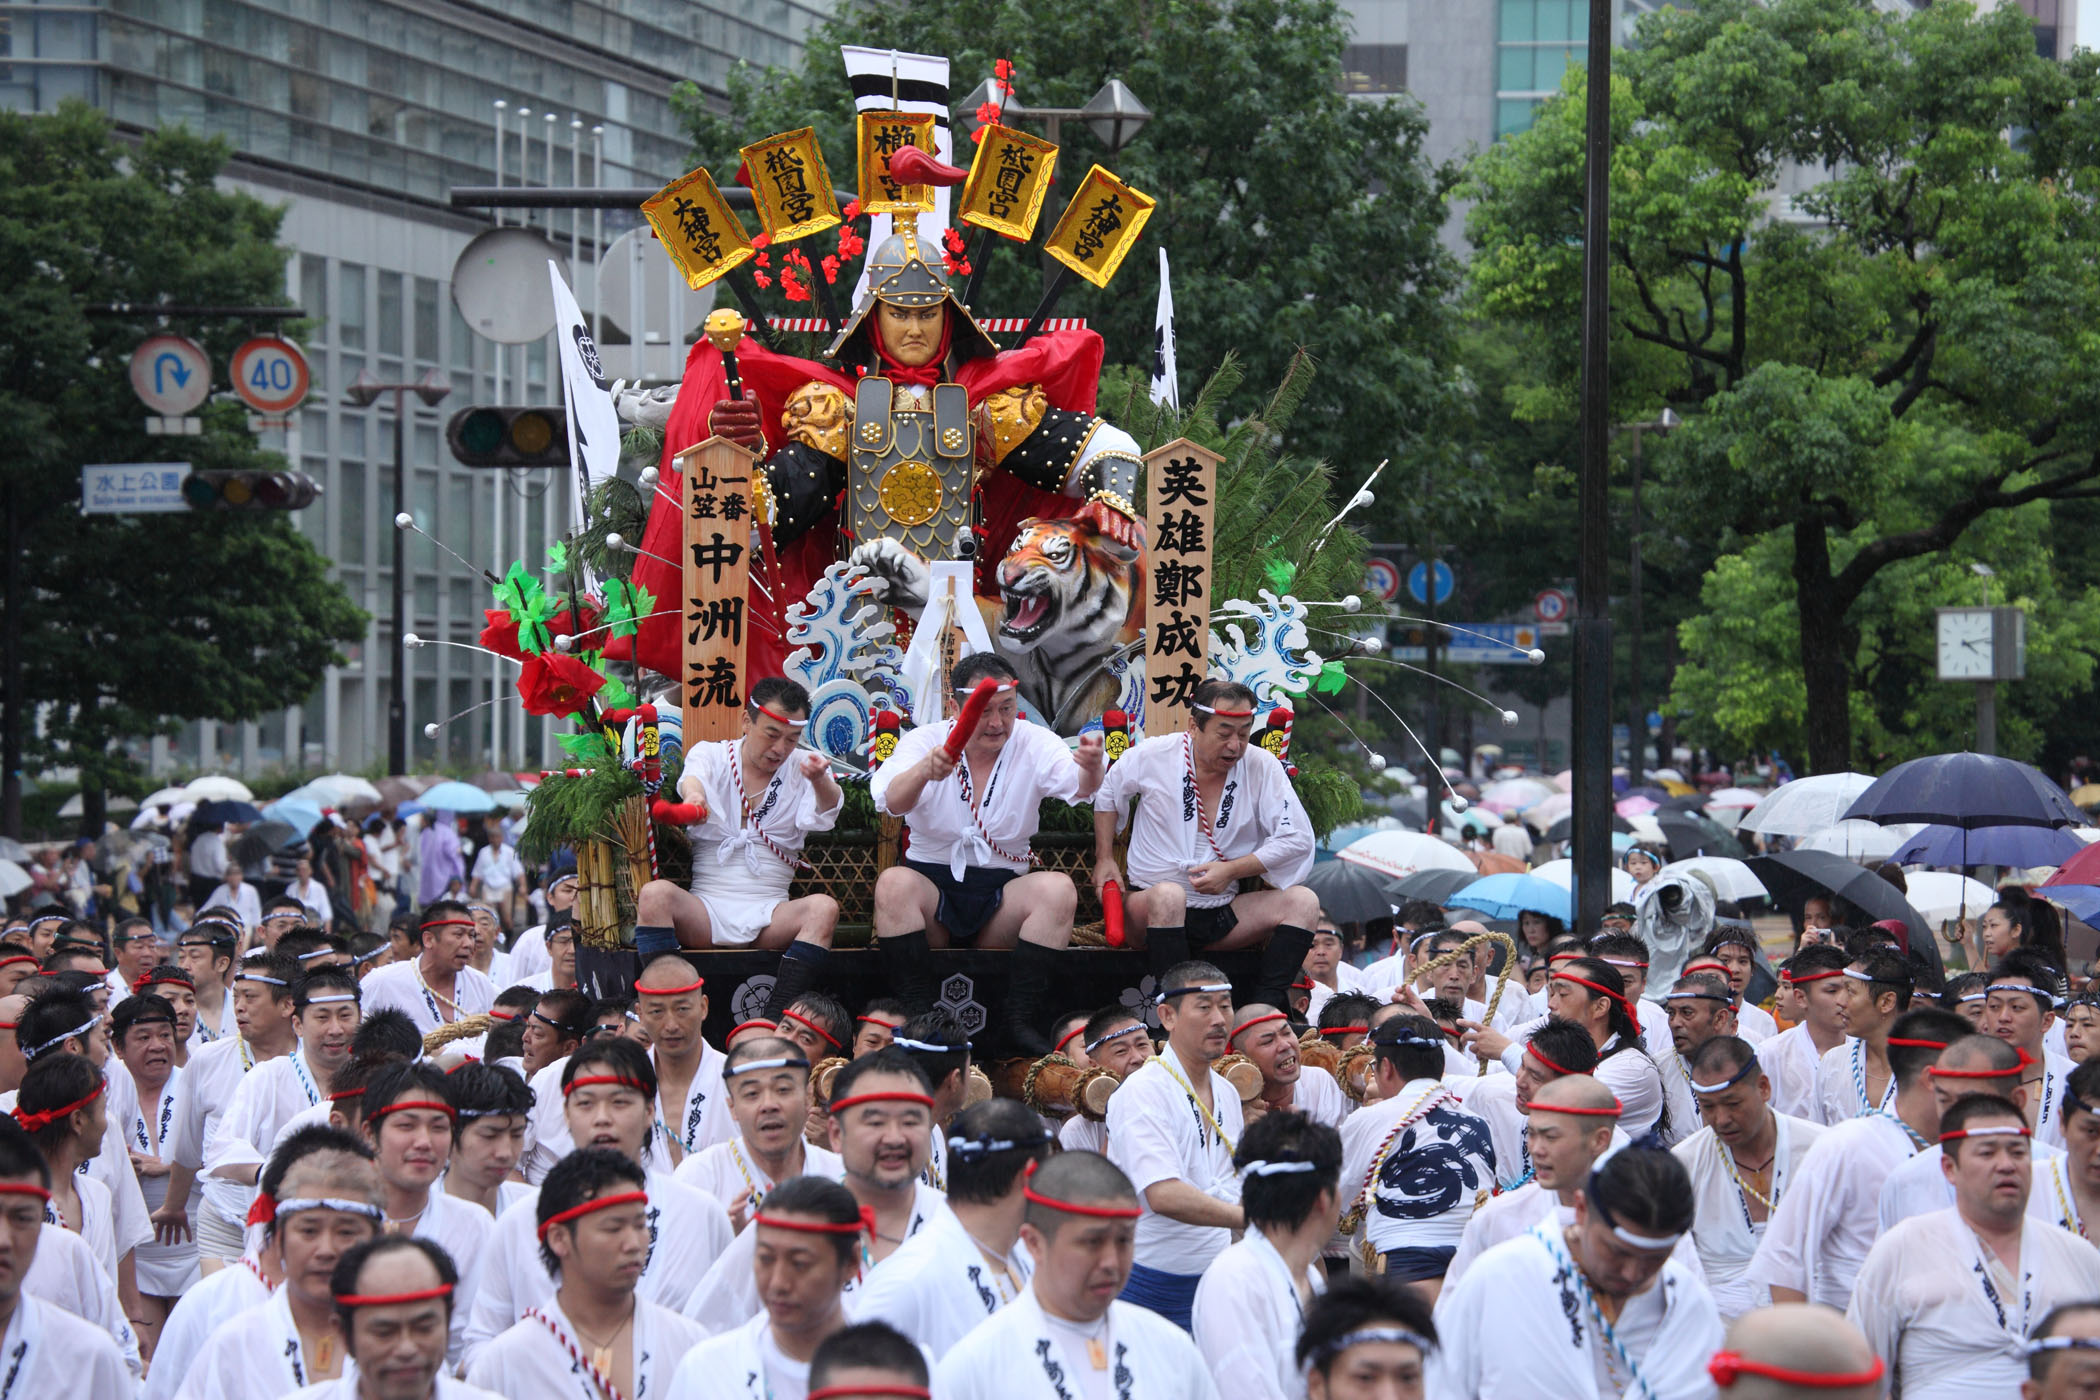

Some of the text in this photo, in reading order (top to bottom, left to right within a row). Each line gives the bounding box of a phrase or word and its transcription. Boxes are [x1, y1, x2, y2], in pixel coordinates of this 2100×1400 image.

[673, 197, 722, 263] 大神宮
[1074, 194, 1123, 262] 大神宮
[251, 358, 291, 391] 40
[95, 471, 180, 492] 水上公園
[690, 466, 718, 520] 山笠
[718, 476, 749, 522] 一番
[1151, 456, 1208, 709] 英雄鄭成功
[687, 532, 744, 709] 中洲流
